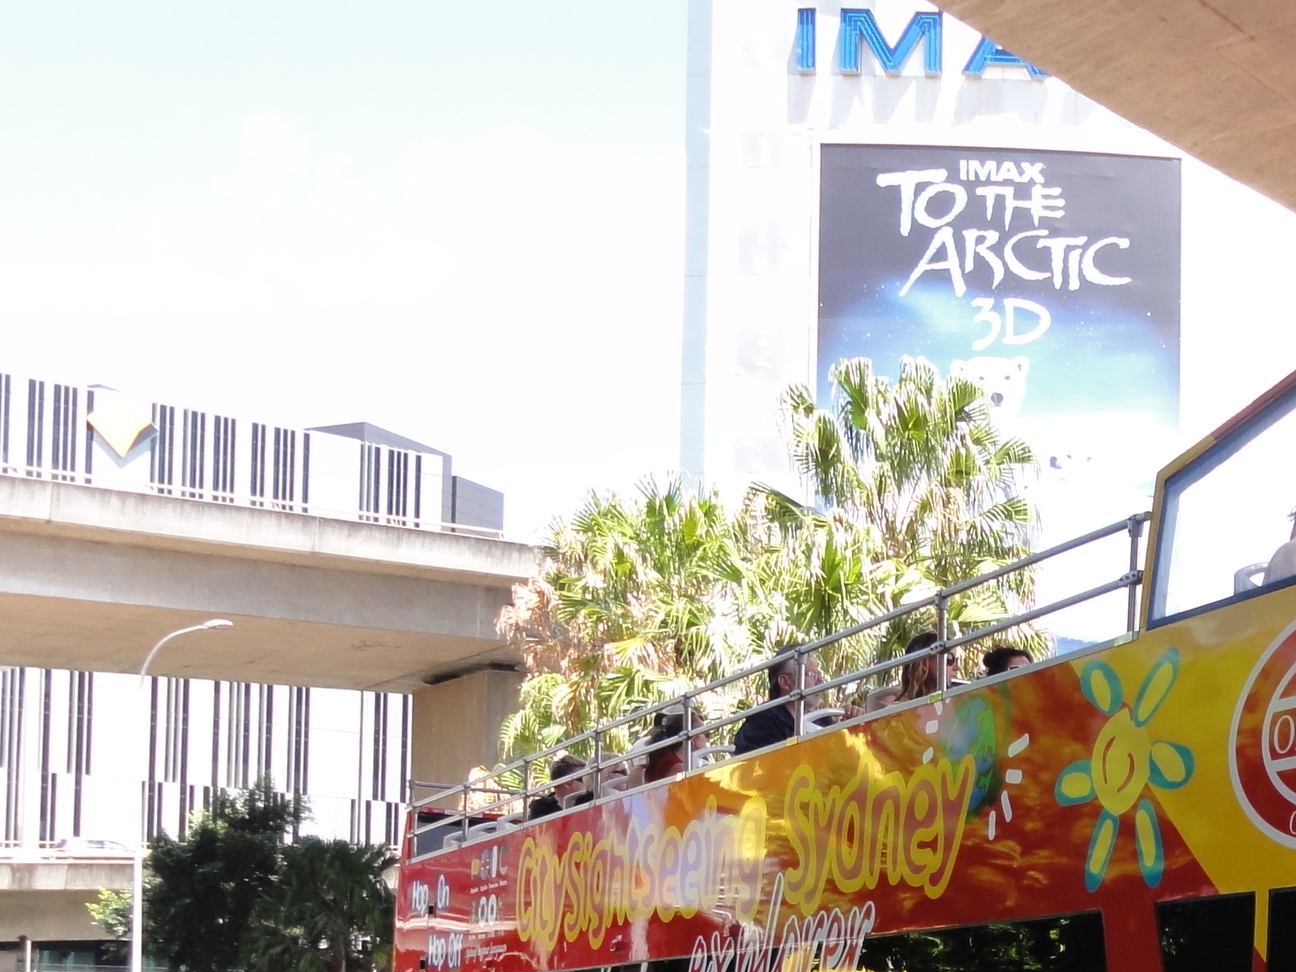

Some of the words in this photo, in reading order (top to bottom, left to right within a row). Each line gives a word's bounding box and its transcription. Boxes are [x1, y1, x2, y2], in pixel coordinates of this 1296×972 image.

[960, 160, 1045, 183] IMAX
[875, 169, 968, 237] TO
[975, 185, 1066, 230] THE
[899, 227, 1132, 297] ARCTIC
[971, 297, 1052, 352] 3D
[784, 754, 976, 916] Sydney
[412, 880, 429, 916] Hop
[437, 874, 450, 909] On
[428, 934, 446, 972] Hop
[448, 932, 463, 968] Off
